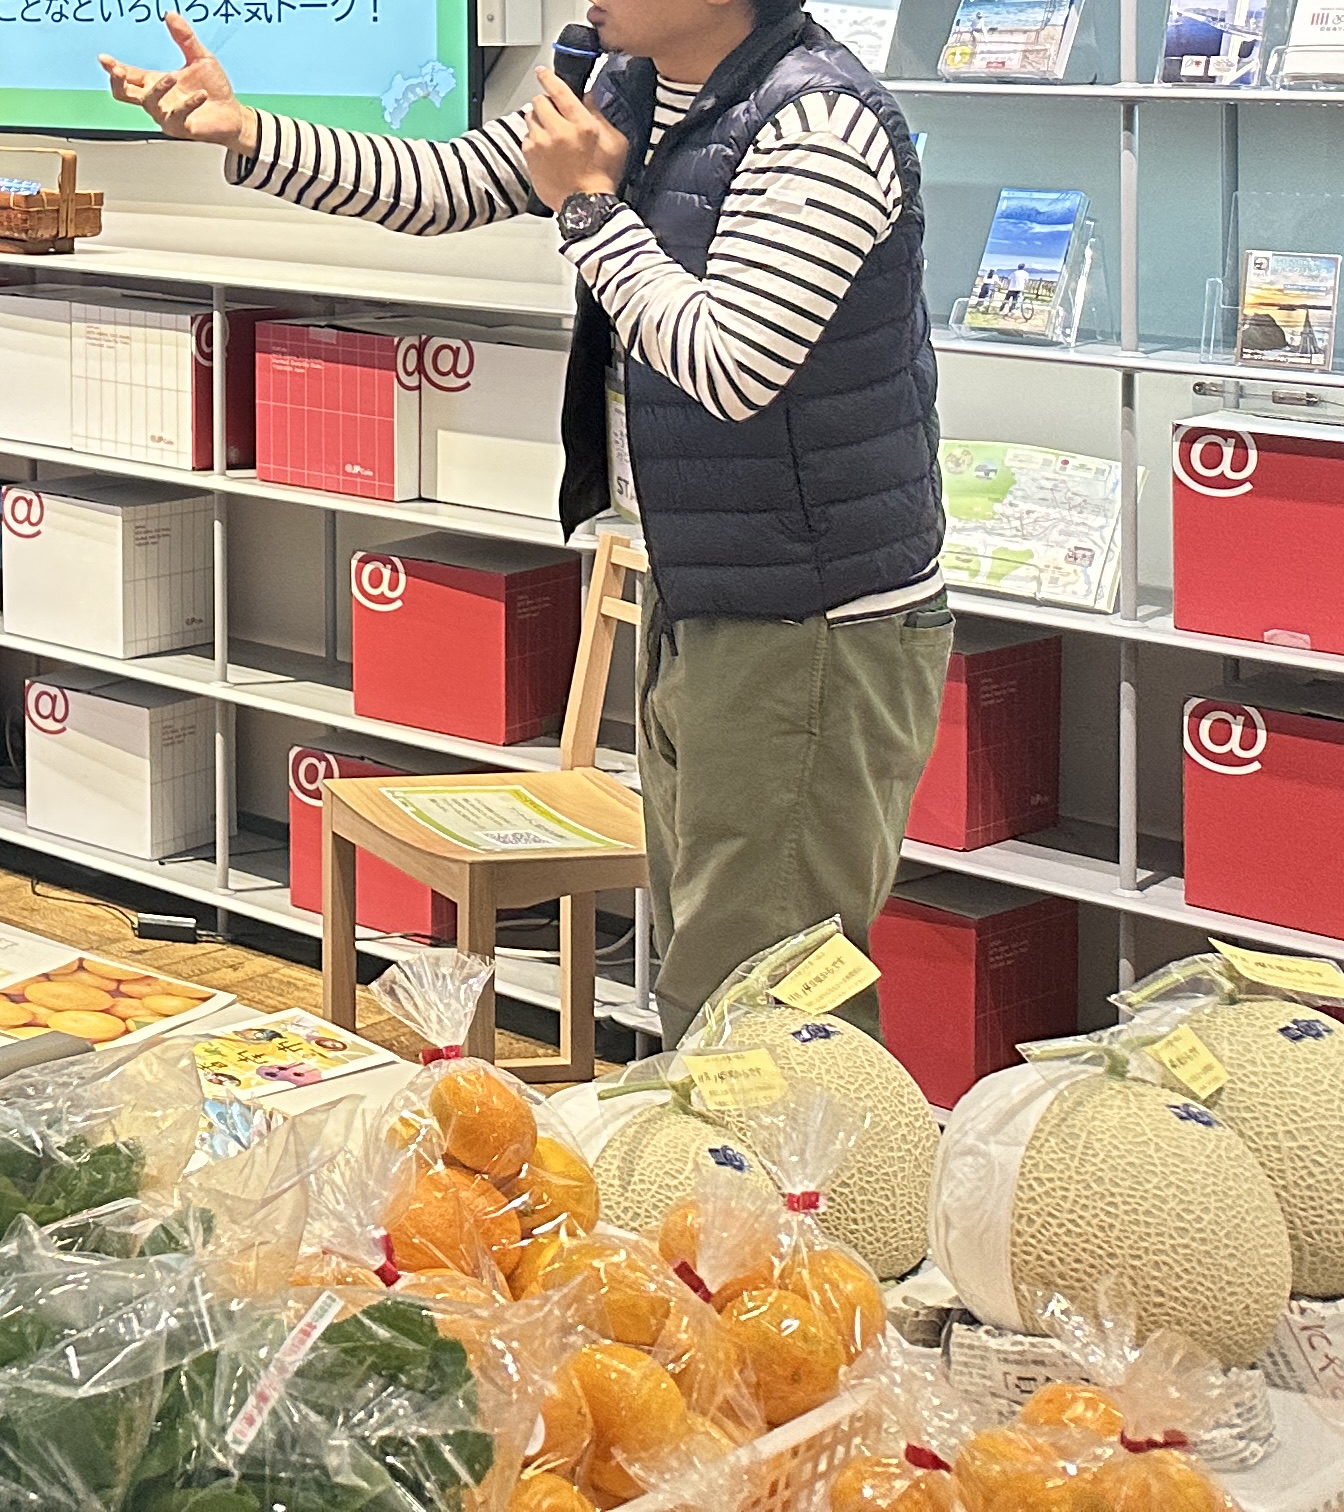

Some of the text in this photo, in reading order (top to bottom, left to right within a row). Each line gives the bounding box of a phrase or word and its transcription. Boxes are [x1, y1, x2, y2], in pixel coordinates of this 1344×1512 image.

[1172, 424, 1259, 498] @
[350, 550, 407, 613] @
[1183, 696, 1268, 776] @
